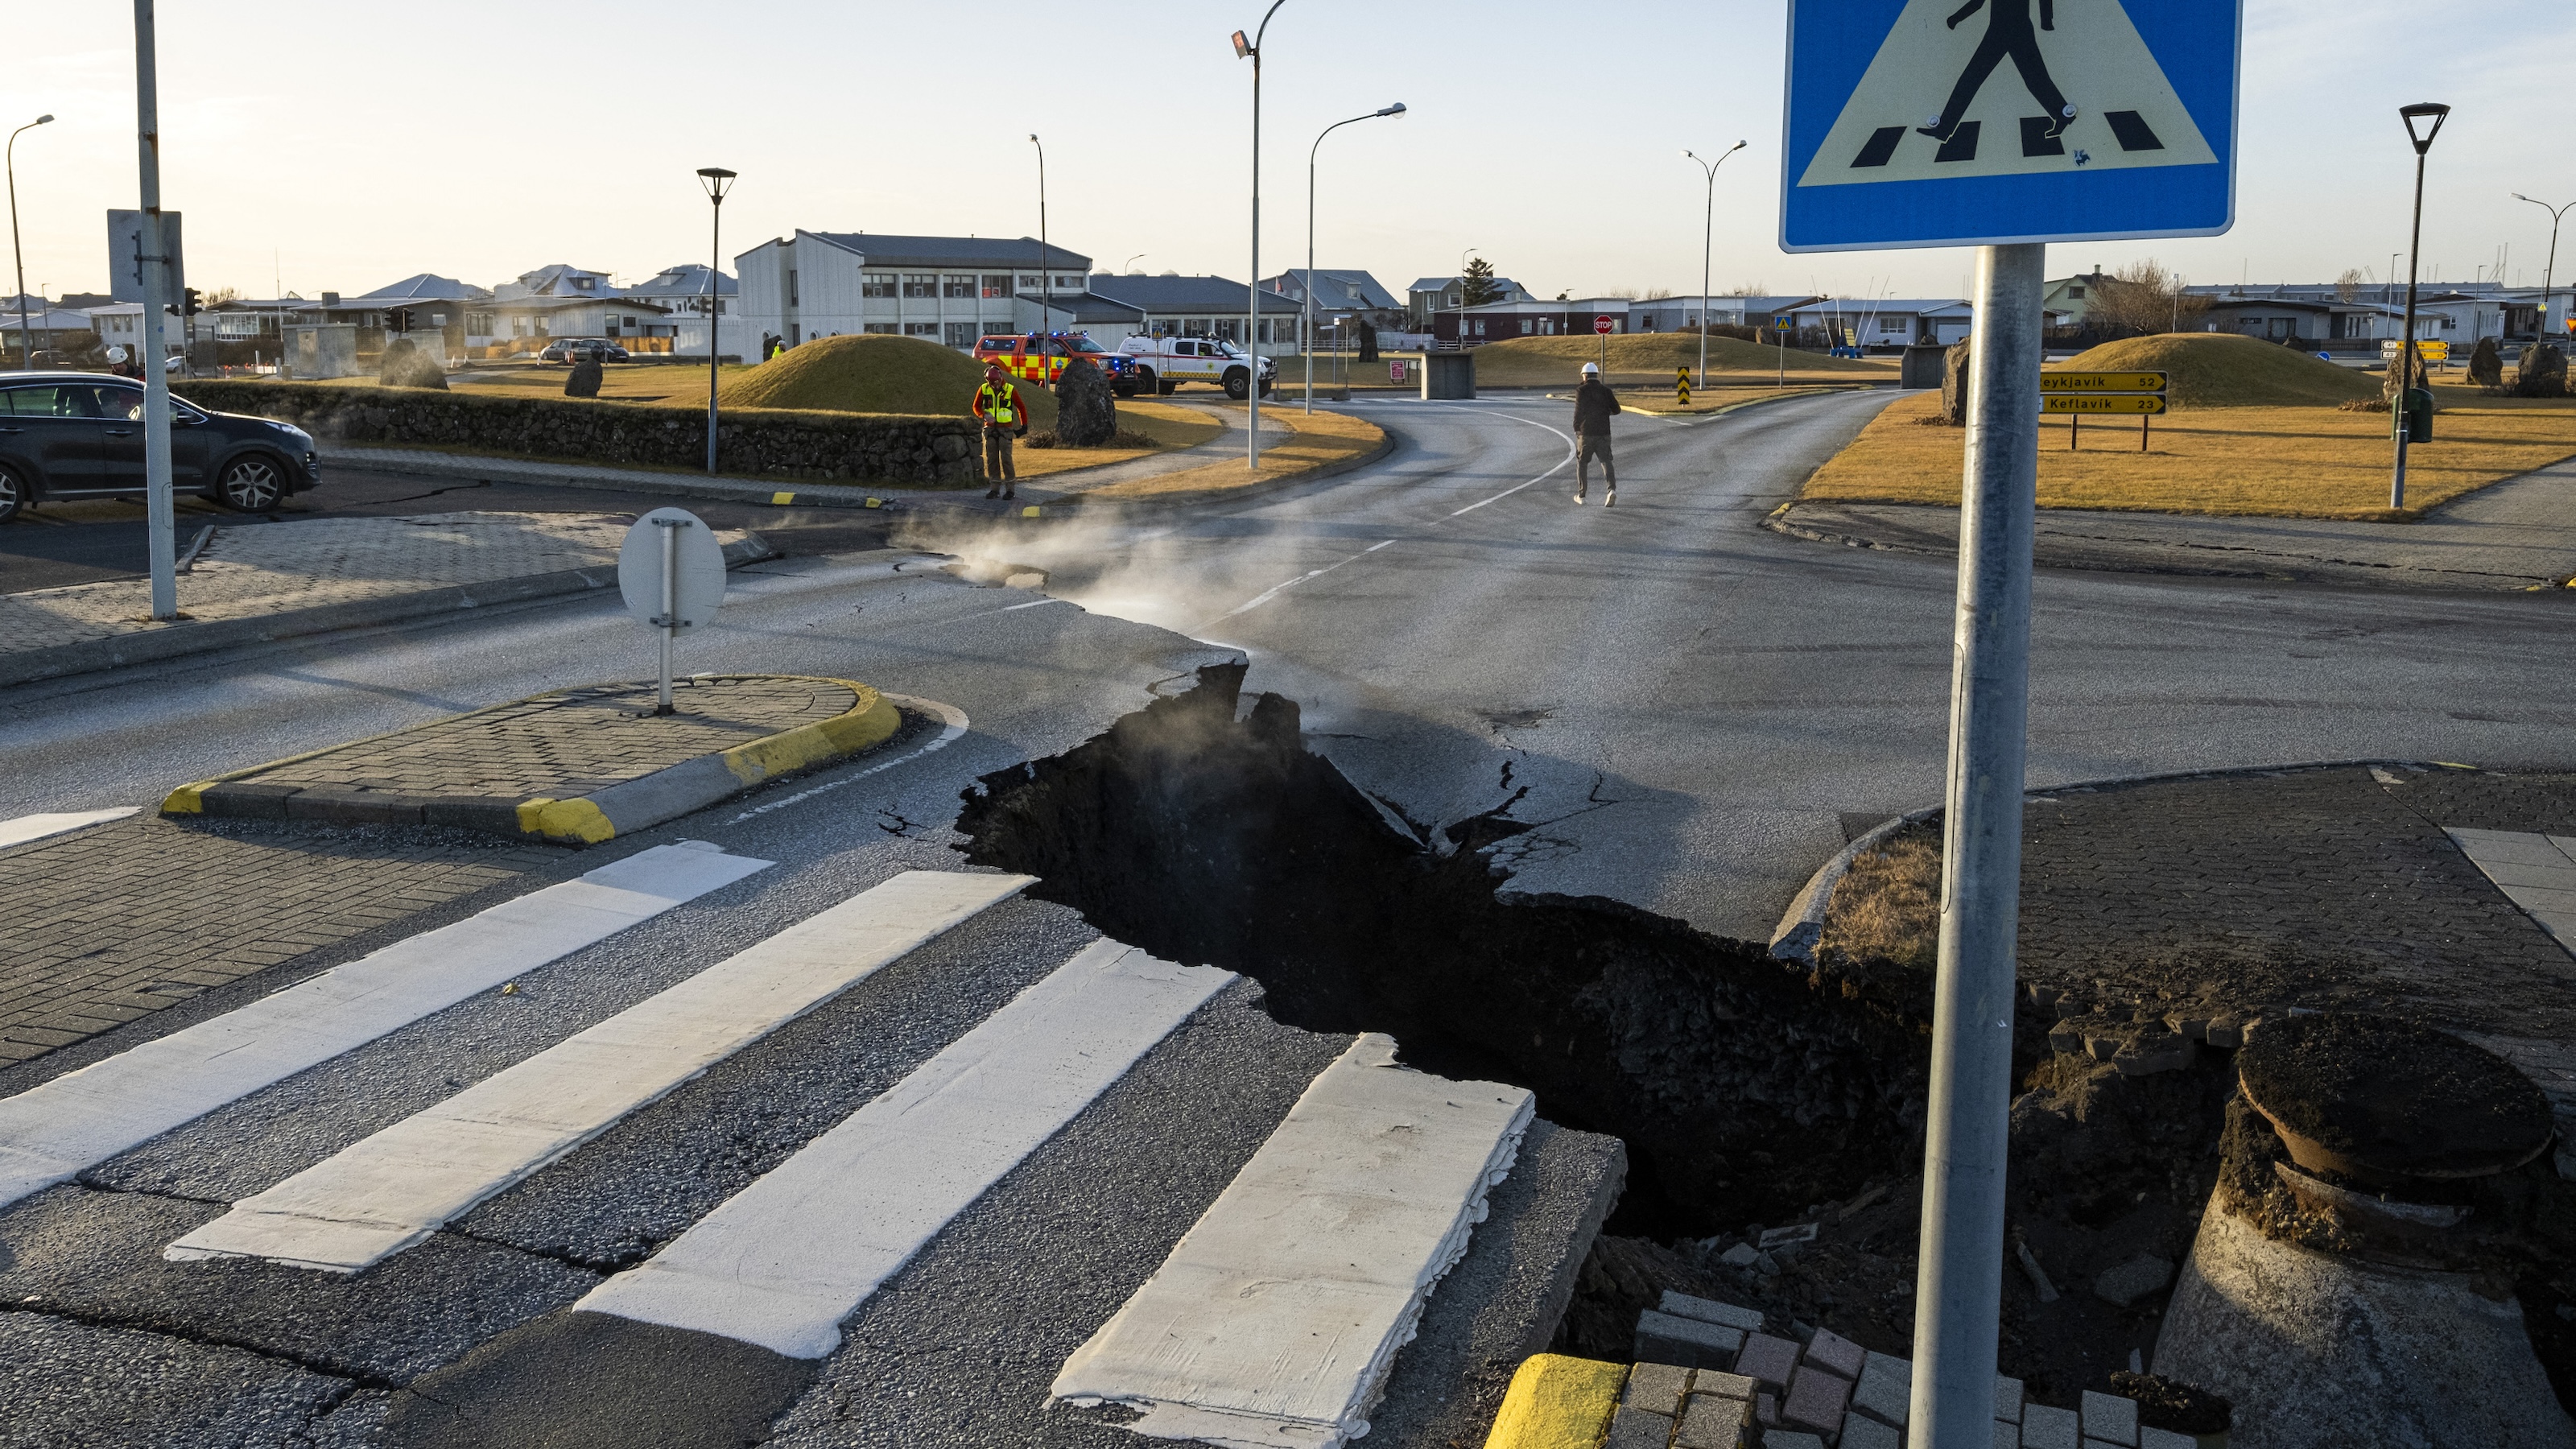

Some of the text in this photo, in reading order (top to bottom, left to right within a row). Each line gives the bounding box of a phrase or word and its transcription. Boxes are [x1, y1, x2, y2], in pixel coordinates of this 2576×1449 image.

[2040, 377, 2155, 388] eykjavík 52
[2050, 398, 2153, 409] Keflavík 23
